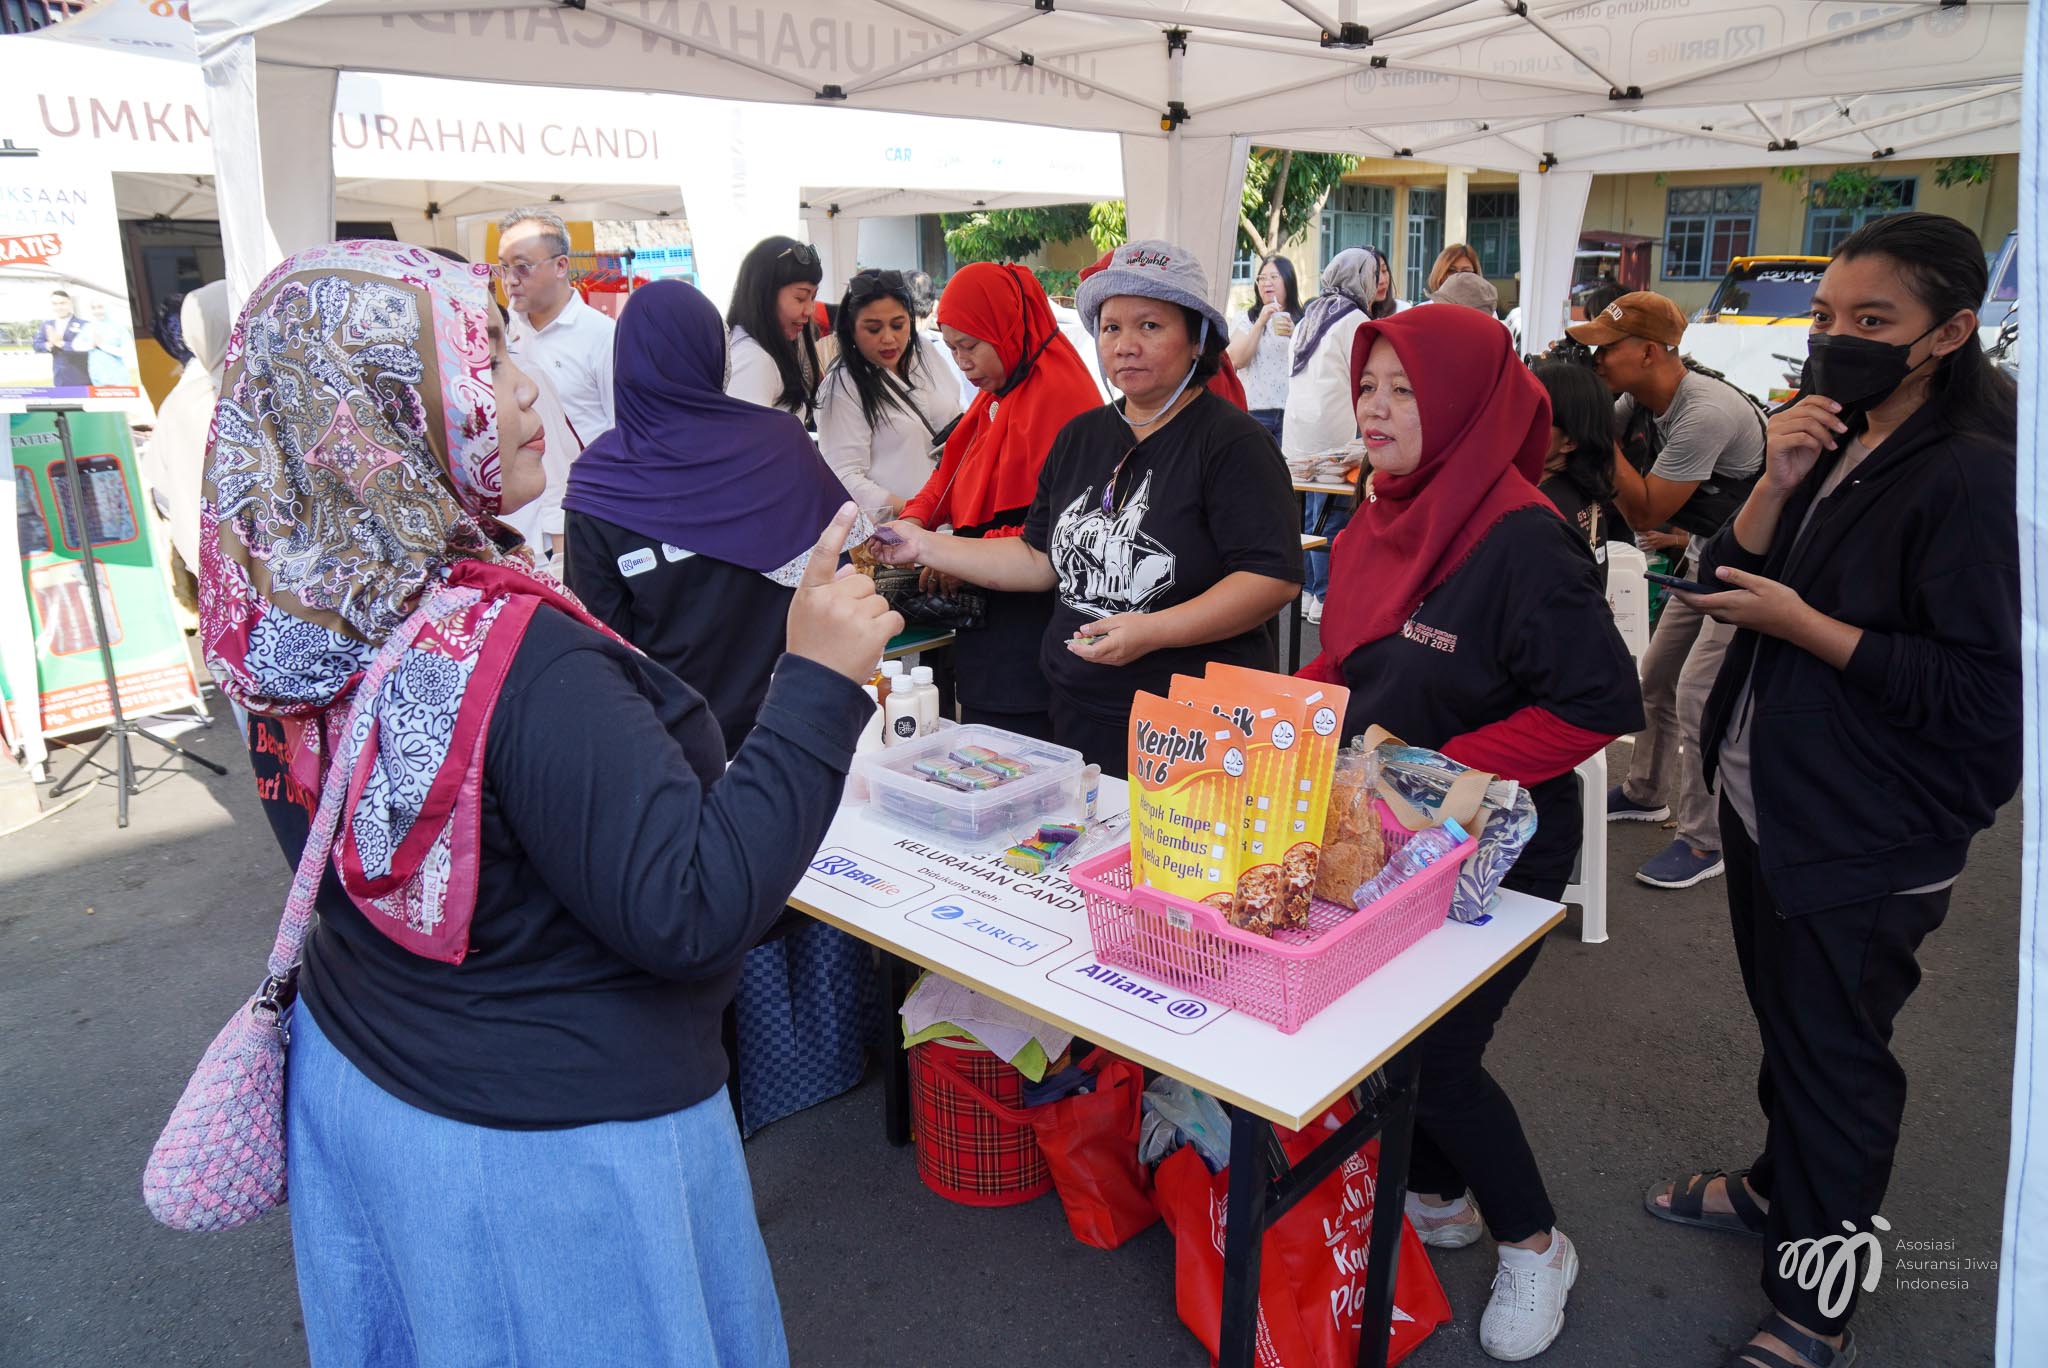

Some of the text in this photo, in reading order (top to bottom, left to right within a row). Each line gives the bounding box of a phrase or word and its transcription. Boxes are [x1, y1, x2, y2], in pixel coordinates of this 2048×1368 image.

[540, 123, 659, 161] CANDI
[885, 147, 912, 162] CAR
[1430, 639, 1456, 653] 2023
[1136, 719, 1208, 765] Keripik
[1169, 808, 1211, 834] Tempe
[1157, 828, 1208, 855] Gembus
[894, 839, 1085, 913] KELURAHAN CANDI
[917, 867, 971, 891] Didukung
[1163, 855, 1204, 879] Peyek
[843, 869, 900, 895] BRIlife
[962, 918, 1039, 951] ZURICH
[1076, 963, 1169, 1006] Allianz
